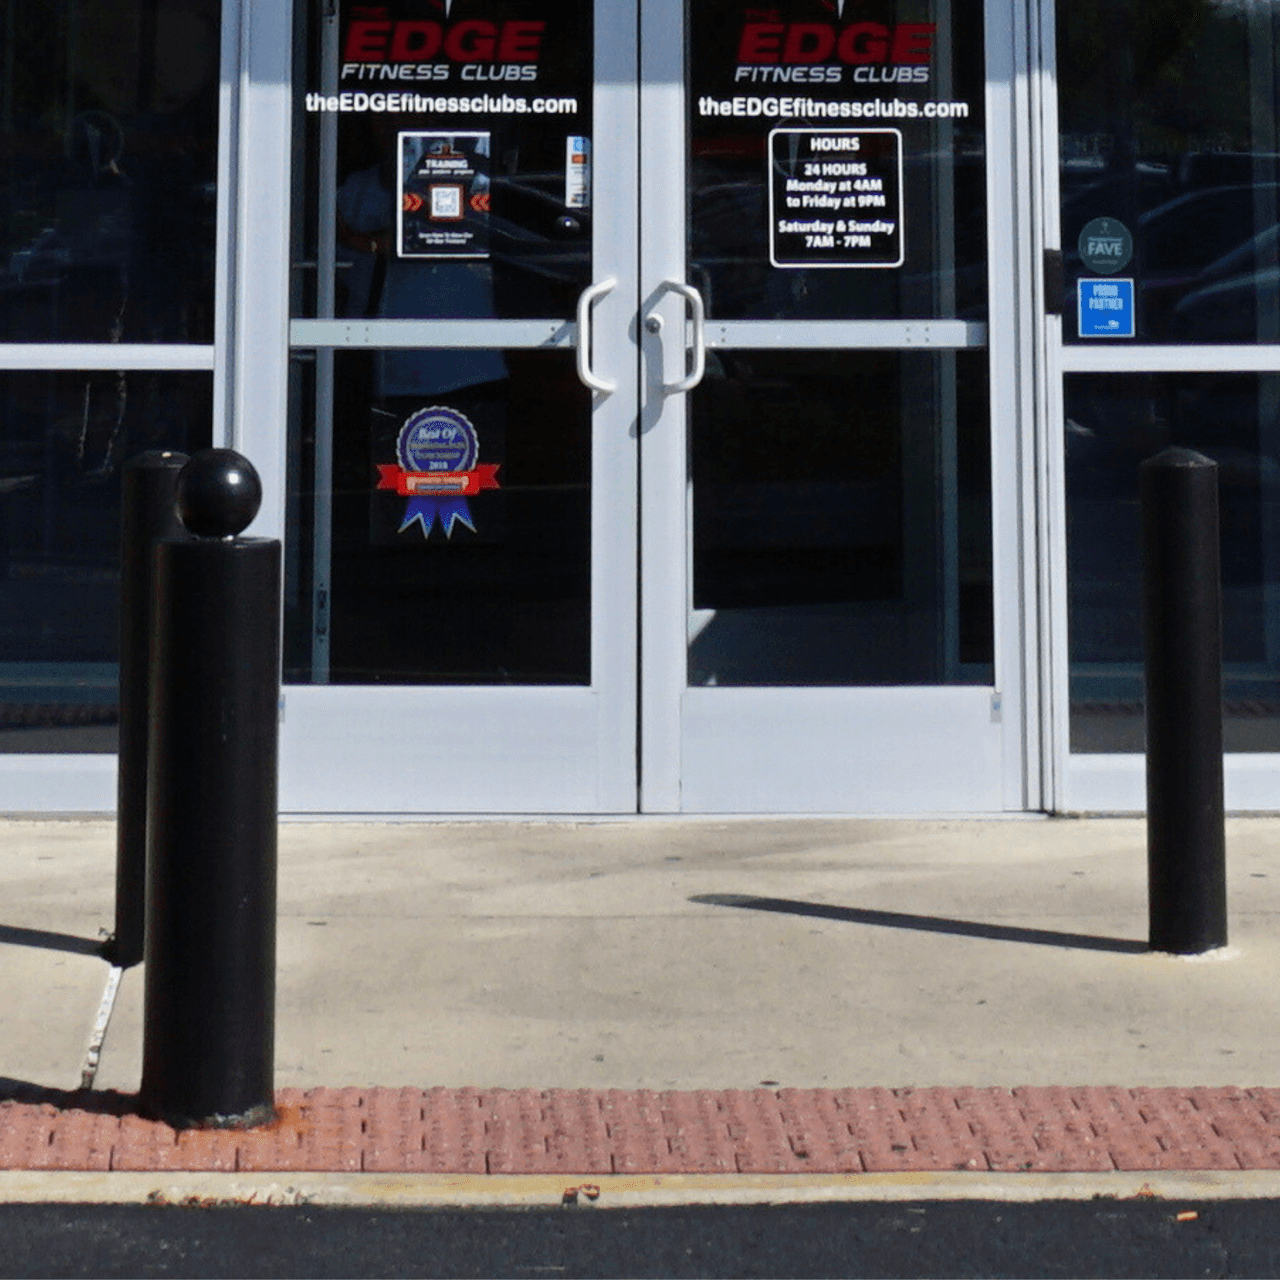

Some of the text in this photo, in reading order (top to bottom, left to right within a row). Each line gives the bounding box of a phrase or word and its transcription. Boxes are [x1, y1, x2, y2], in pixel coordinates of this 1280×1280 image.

[343, 20, 546, 62] EDGE
[736, 22, 937, 64] EDGE
[341, 63, 538, 81] FITNESS CLUBS
[734, 66, 929, 83] FITNESS CLUBS
[305, 92, 578, 114] theEDGEfitnessclubs.com
[698, 96, 969, 118] theEDGEfitnessclubs.com
[810, 136, 860, 151] HOURS
[804, 163, 867, 176] 24 HOURS
[786, 178, 883, 194] Monday at 4AM
[786, 194, 886, 210] to Friday at 9PM
[778, 219, 895, 235] Saturday & Sunday
[805, 235, 835, 248] 7AM
[843, 235, 872, 248] 7PM
[1087, 242, 1123, 256] FAVE
